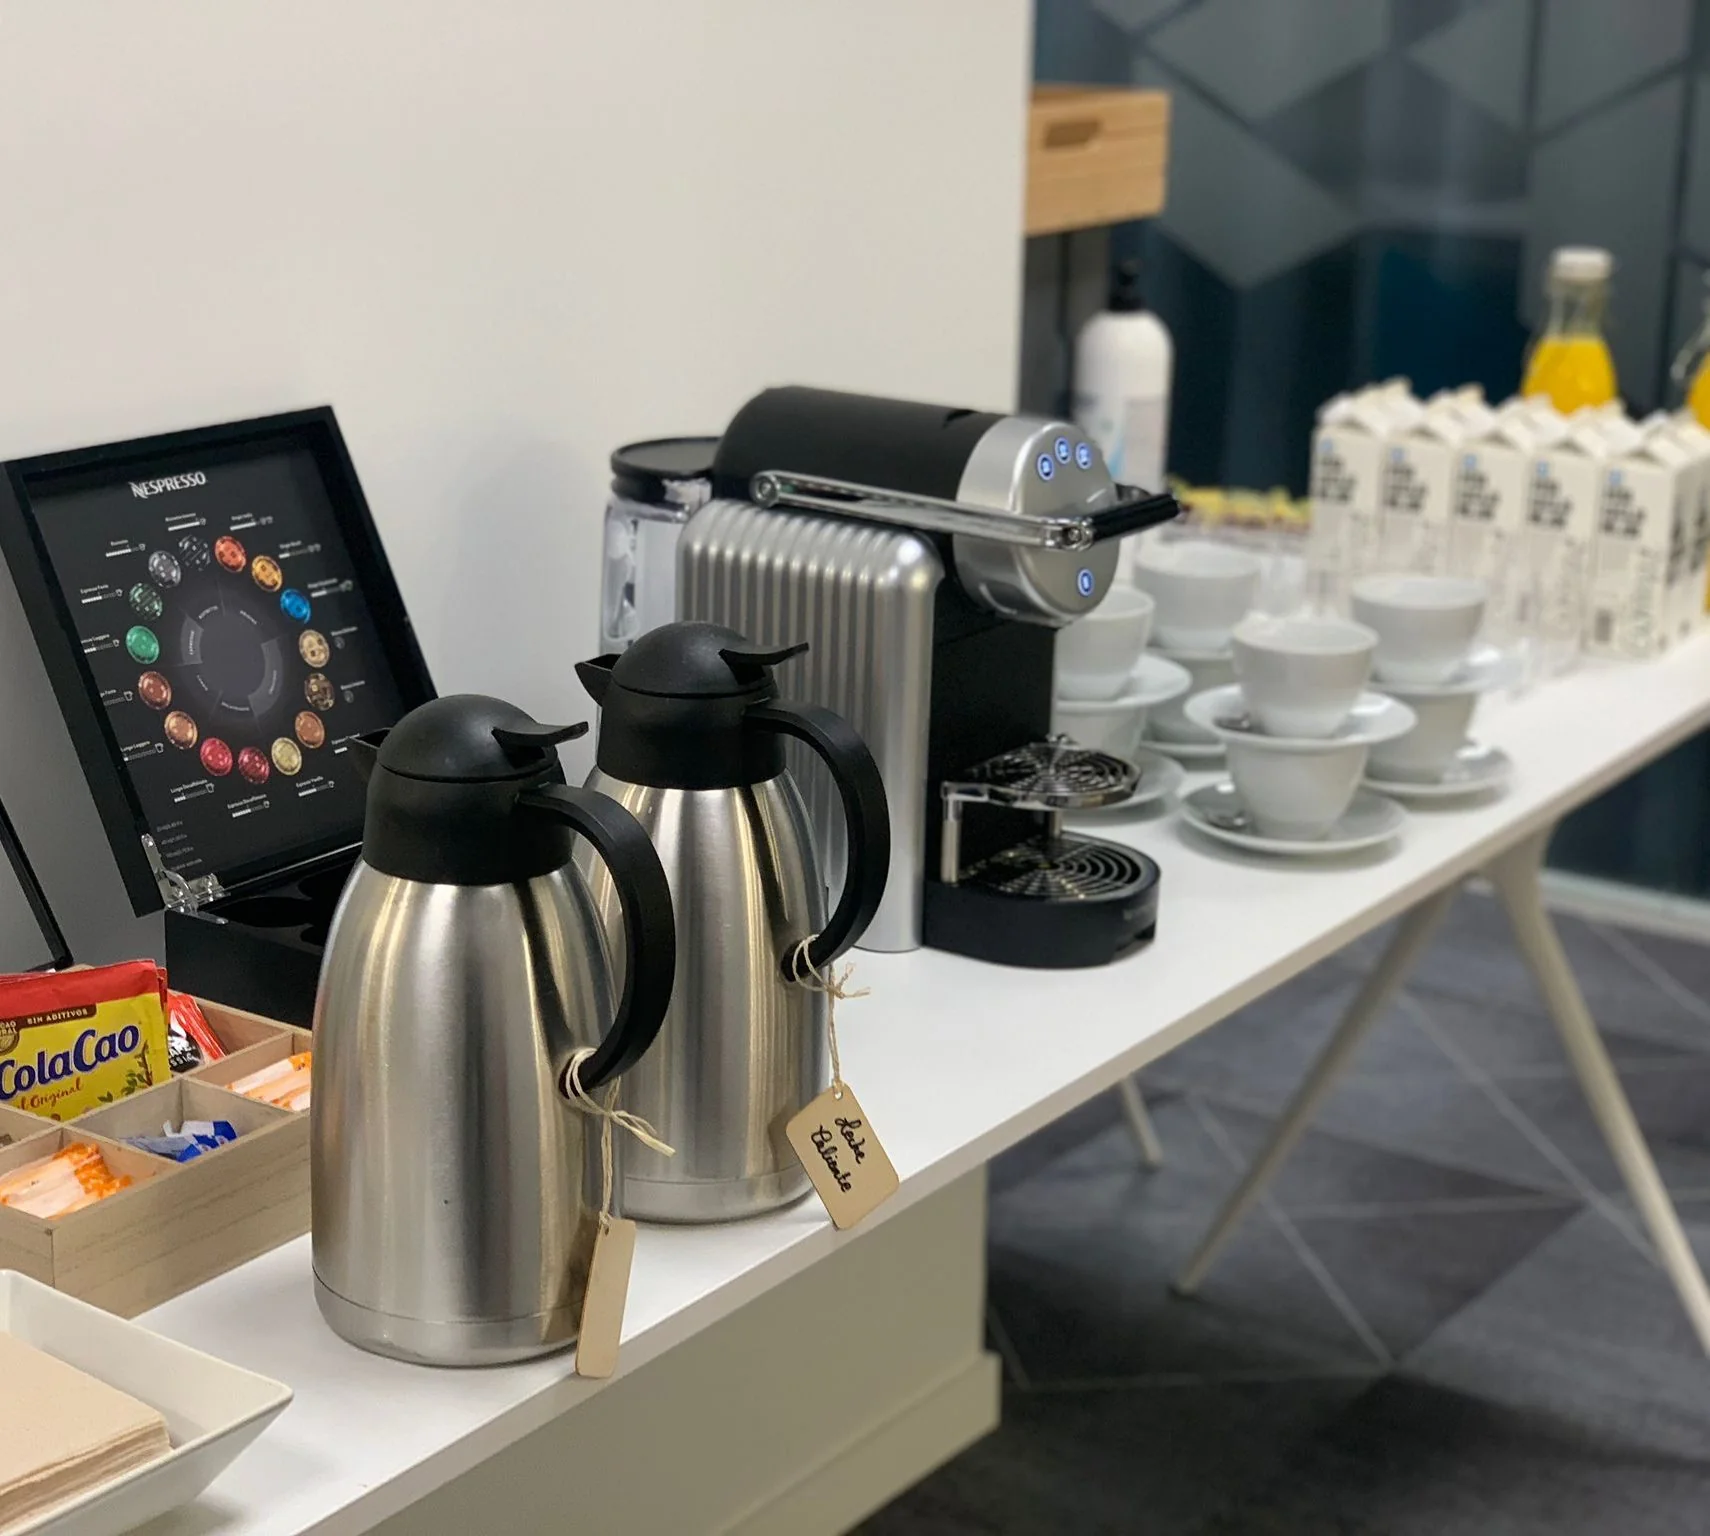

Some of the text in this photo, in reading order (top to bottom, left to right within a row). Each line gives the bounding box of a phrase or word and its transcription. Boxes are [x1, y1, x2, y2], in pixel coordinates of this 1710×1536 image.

[128, 471, 207, 499] NESPRESSO
[27, 1008, 88, 1025] SIN ADITIVOS
[0, 1025, 140, 1101] ColaCao
[29, 1076, 83, 1109] Original
[810, 1124, 852, 1193] Caliente
